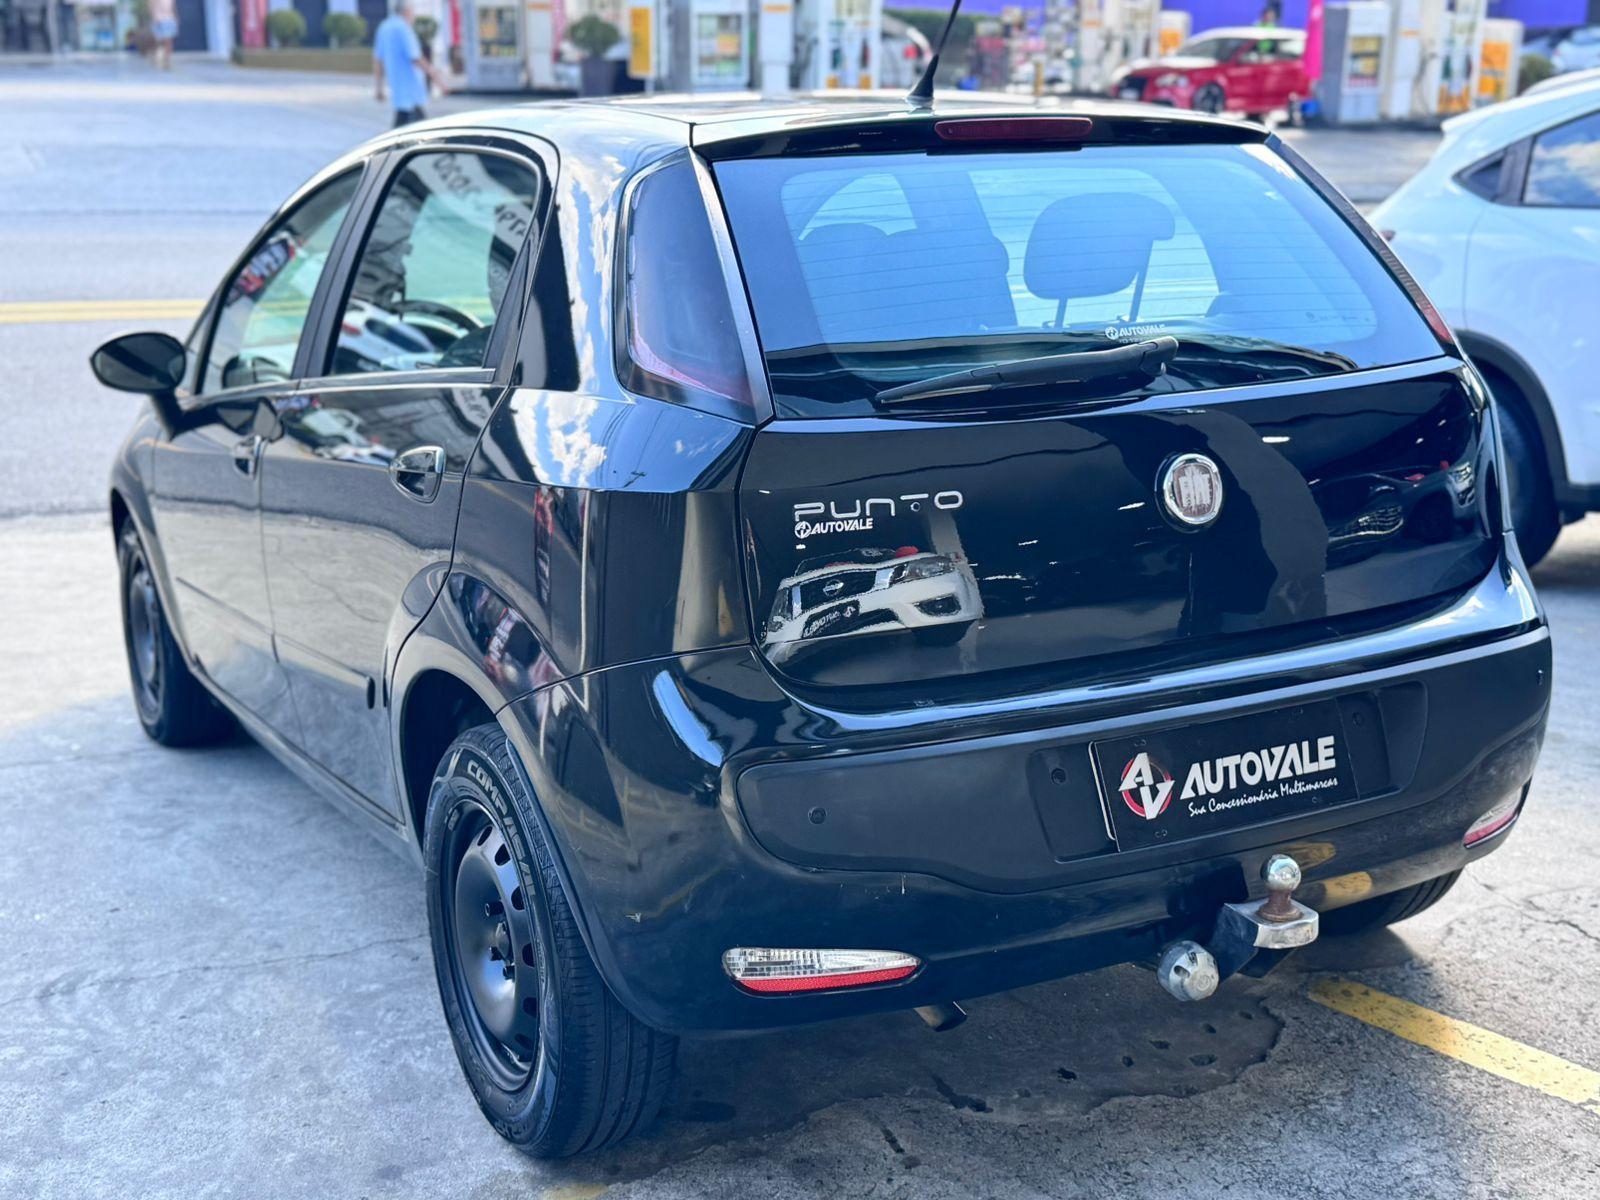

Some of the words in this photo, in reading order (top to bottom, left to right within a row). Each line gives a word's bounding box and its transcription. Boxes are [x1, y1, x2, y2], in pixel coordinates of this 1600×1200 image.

[1119, 324, 1166, 337] AUTOVALE
[794, 490, 964, 522] PUNTO
[811, 517, 874, 536] AUTOVALE
[1180, 735, 1337, 800] AUTOVALE
[1188, 800, 1207, 817] Sua
[1279, 776, 1339, 797] Multimarcas
